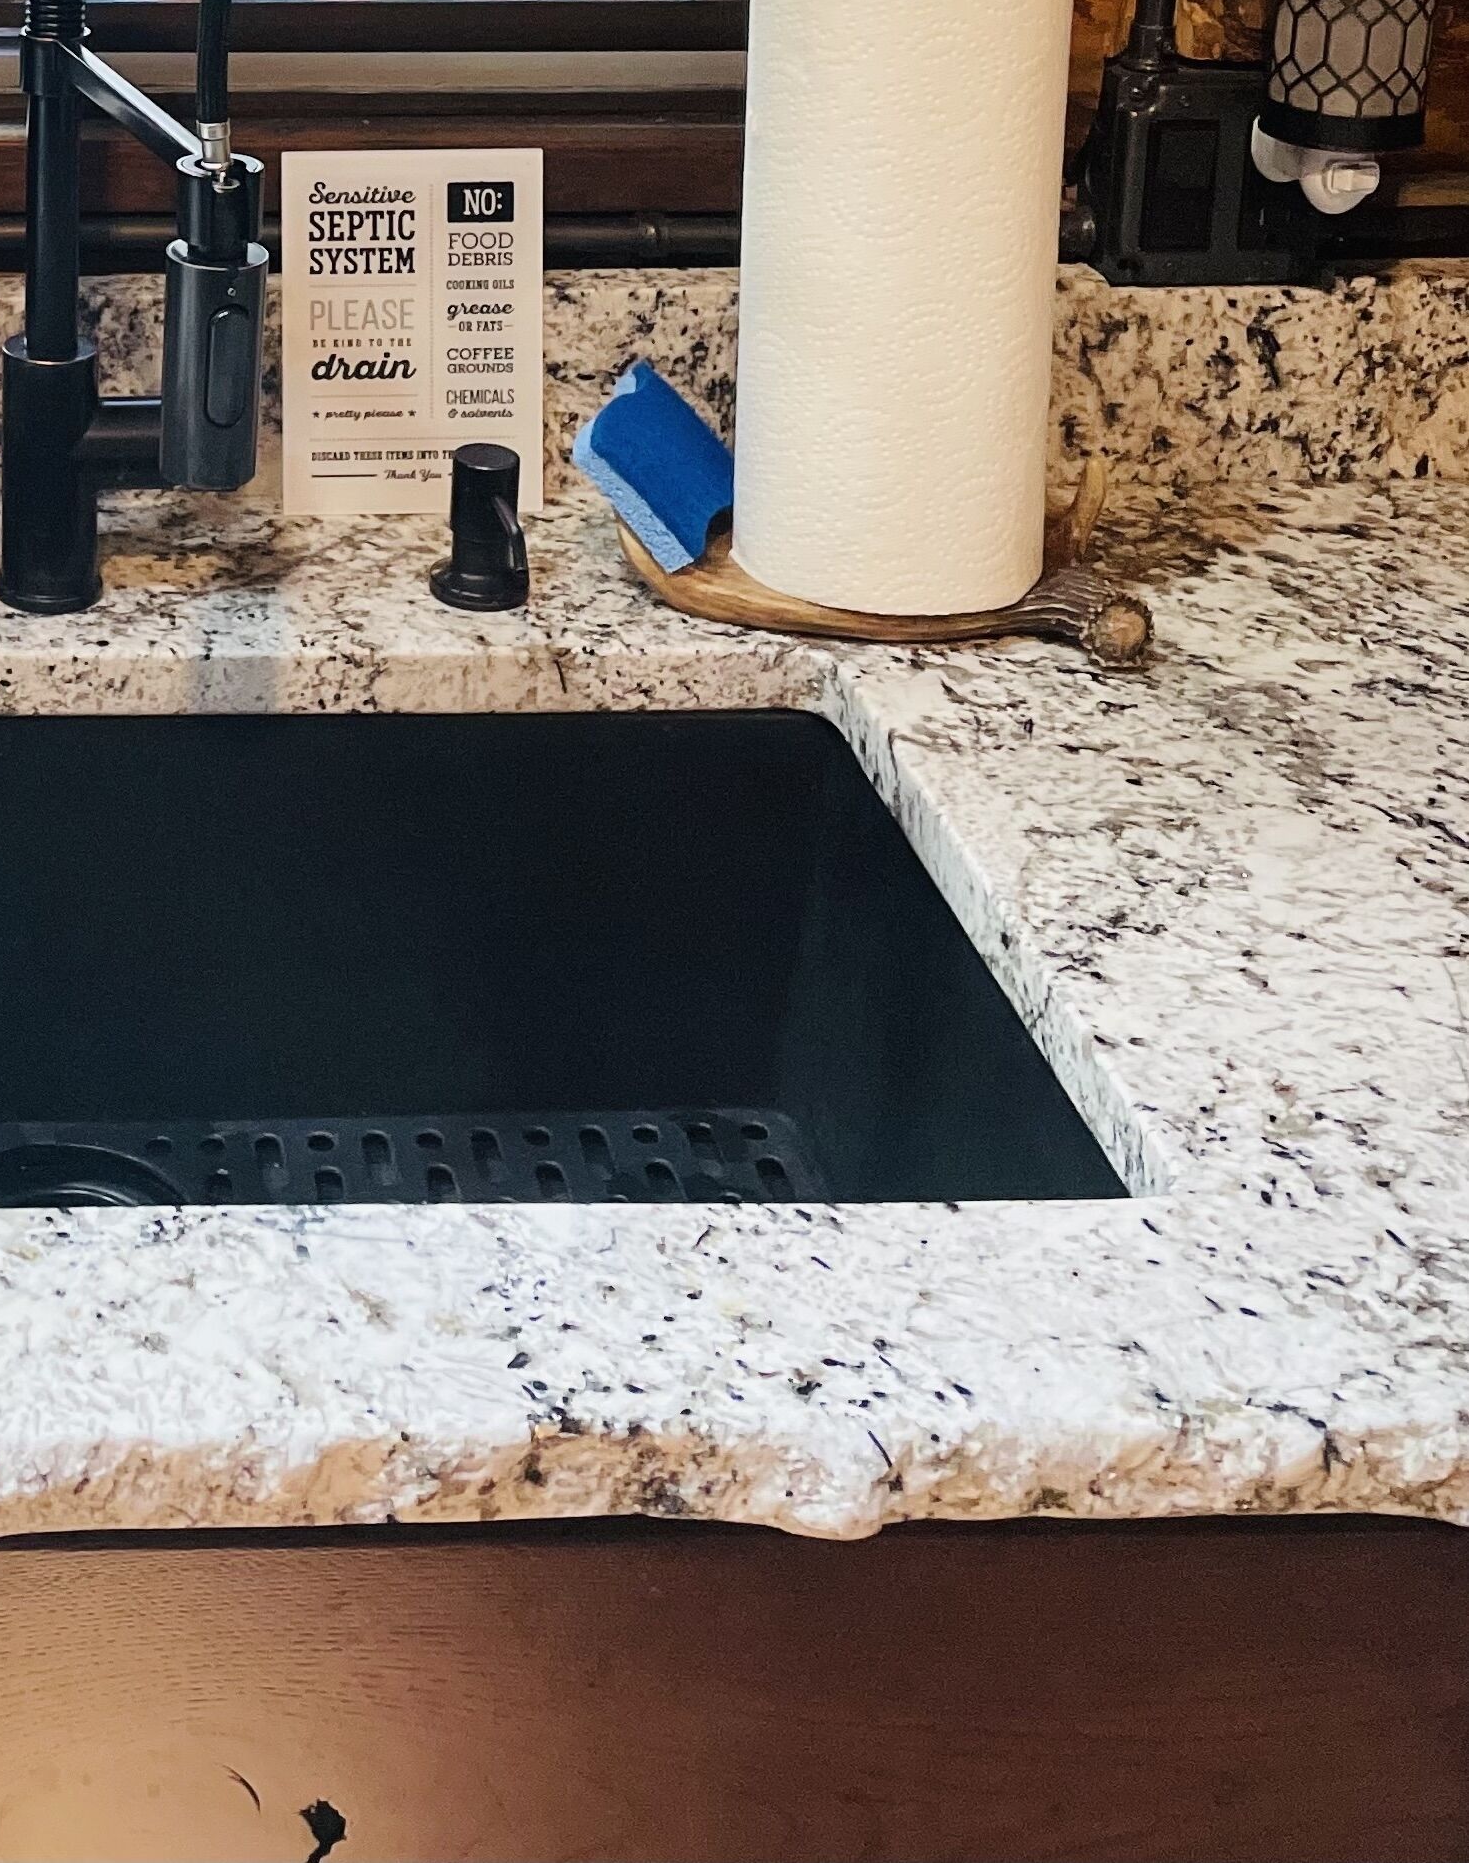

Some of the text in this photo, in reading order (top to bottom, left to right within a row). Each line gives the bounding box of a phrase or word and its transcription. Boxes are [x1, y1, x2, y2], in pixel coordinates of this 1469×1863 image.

[308, 181, 416, 204] Sensitive
[463, 188, 503, 216] NO:
[308, 210, 416, 241] SEPTIC
[448, 232, 514, 250] FOOD
[309, 247, 416, 274] SYSTEM
[447, 252, 513, 266] DEBRIS
[446, 279, 515, 290] COOKING OILS
[310, 298, 415, 330] PLEASE
[447, 303, 515, 321] grease
[458, 320, 503, 332] OR FATS
[446, 347, 515, 361] COFFEE
[311, 351, 417, 381] drain
[447, 363, 514, 374] GROUNDS
[446, 389, 515, 405] CHEMICALS
[324, 410, 404, 421] pretty please
[460, 409, 514, 419] solvents
[384, 468, 442, 482] Thank You
